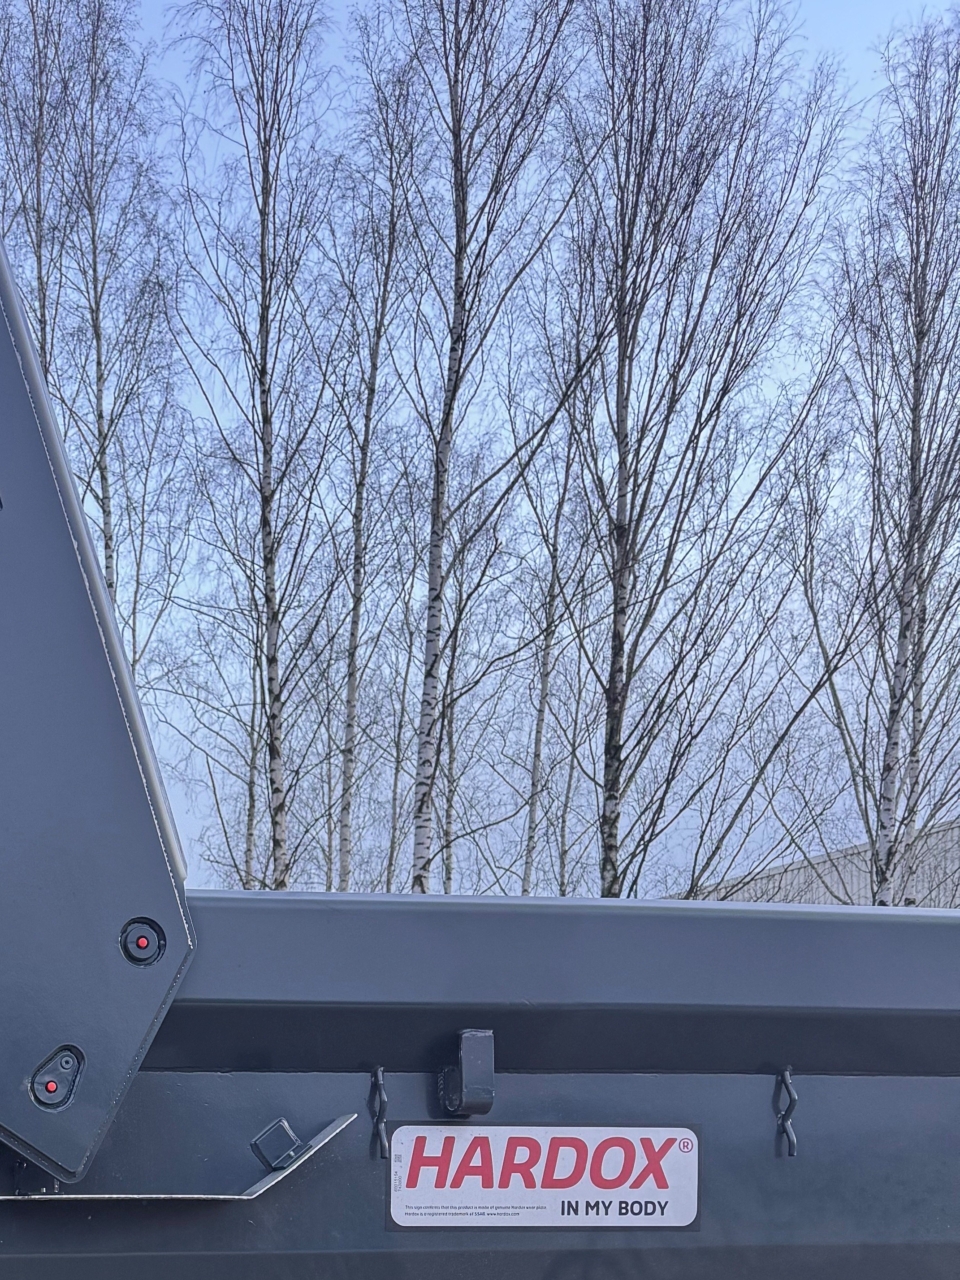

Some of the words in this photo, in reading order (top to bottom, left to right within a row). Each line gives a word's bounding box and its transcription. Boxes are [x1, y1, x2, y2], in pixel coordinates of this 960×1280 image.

[560, 1200, 580, 1216] IN
[585, 1200, 613, 1216] MY
[618, 1200, 669, 1216] BODY
